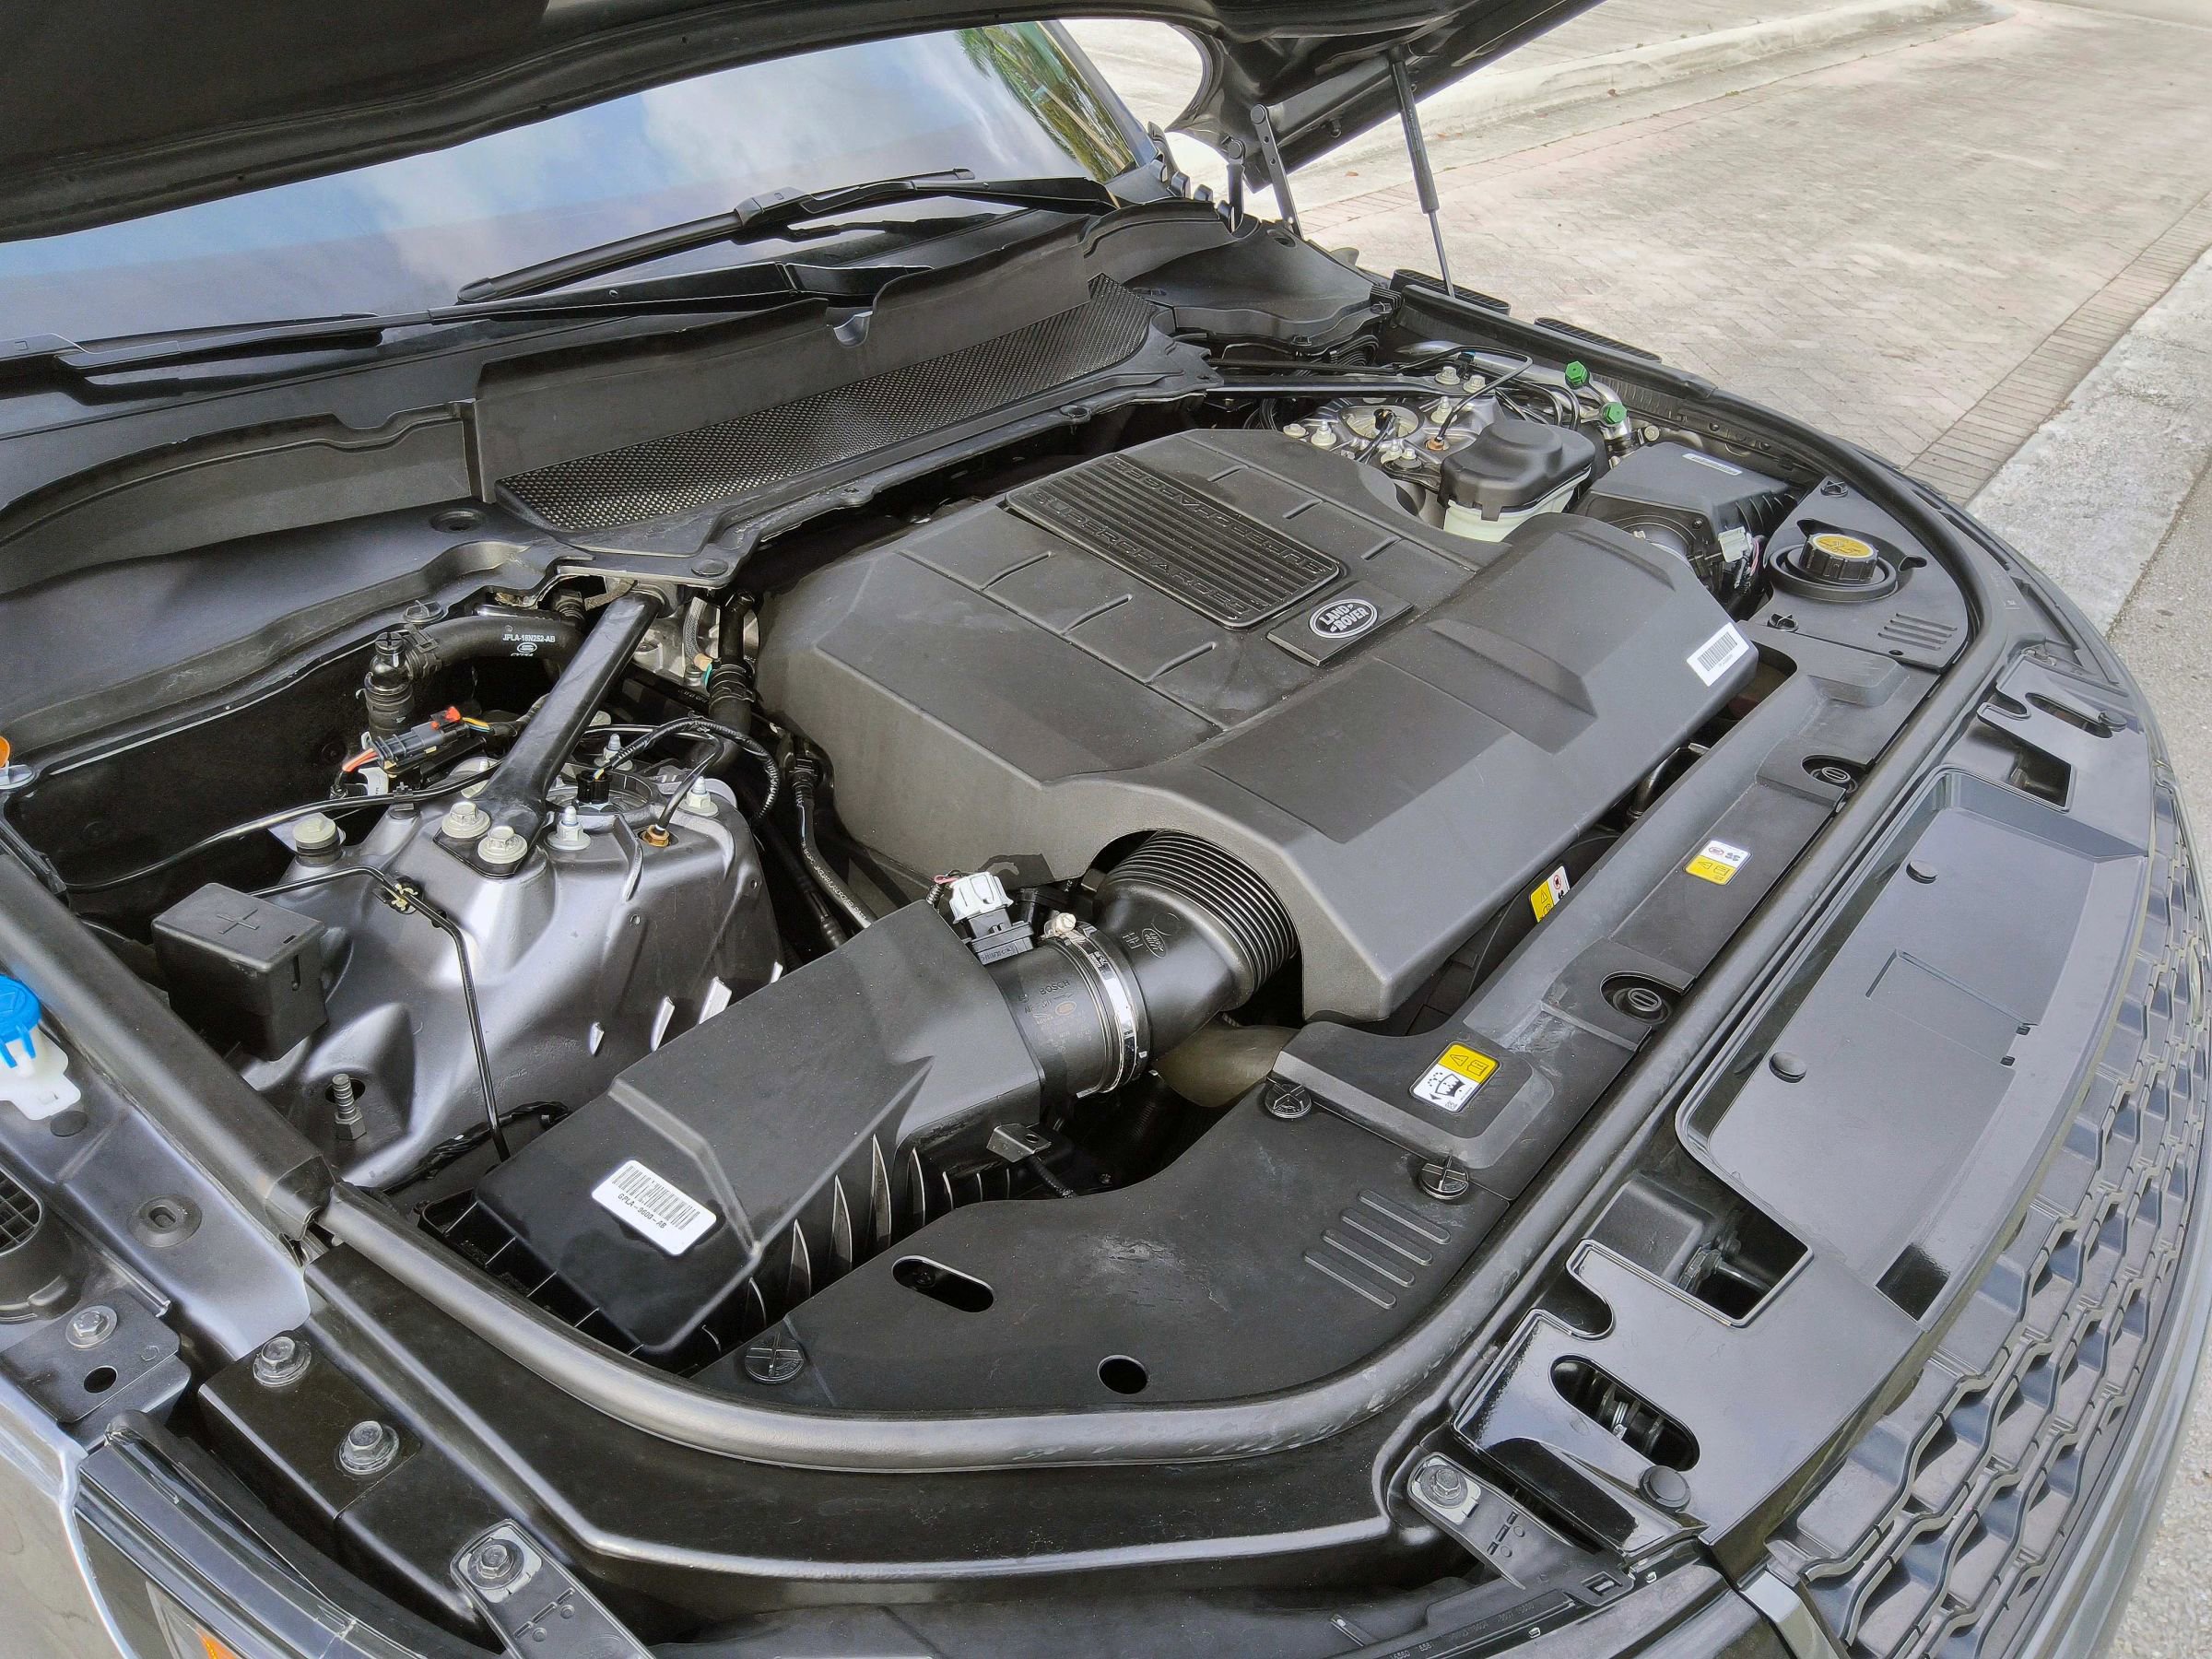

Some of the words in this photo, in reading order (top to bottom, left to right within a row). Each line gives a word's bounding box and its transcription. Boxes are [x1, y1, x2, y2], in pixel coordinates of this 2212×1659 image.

[1319, 604, 1352, 626] LAND
[1332, 606, 1370, 631] ROVER
[1039, 979, 1071, 995] BOSCH
